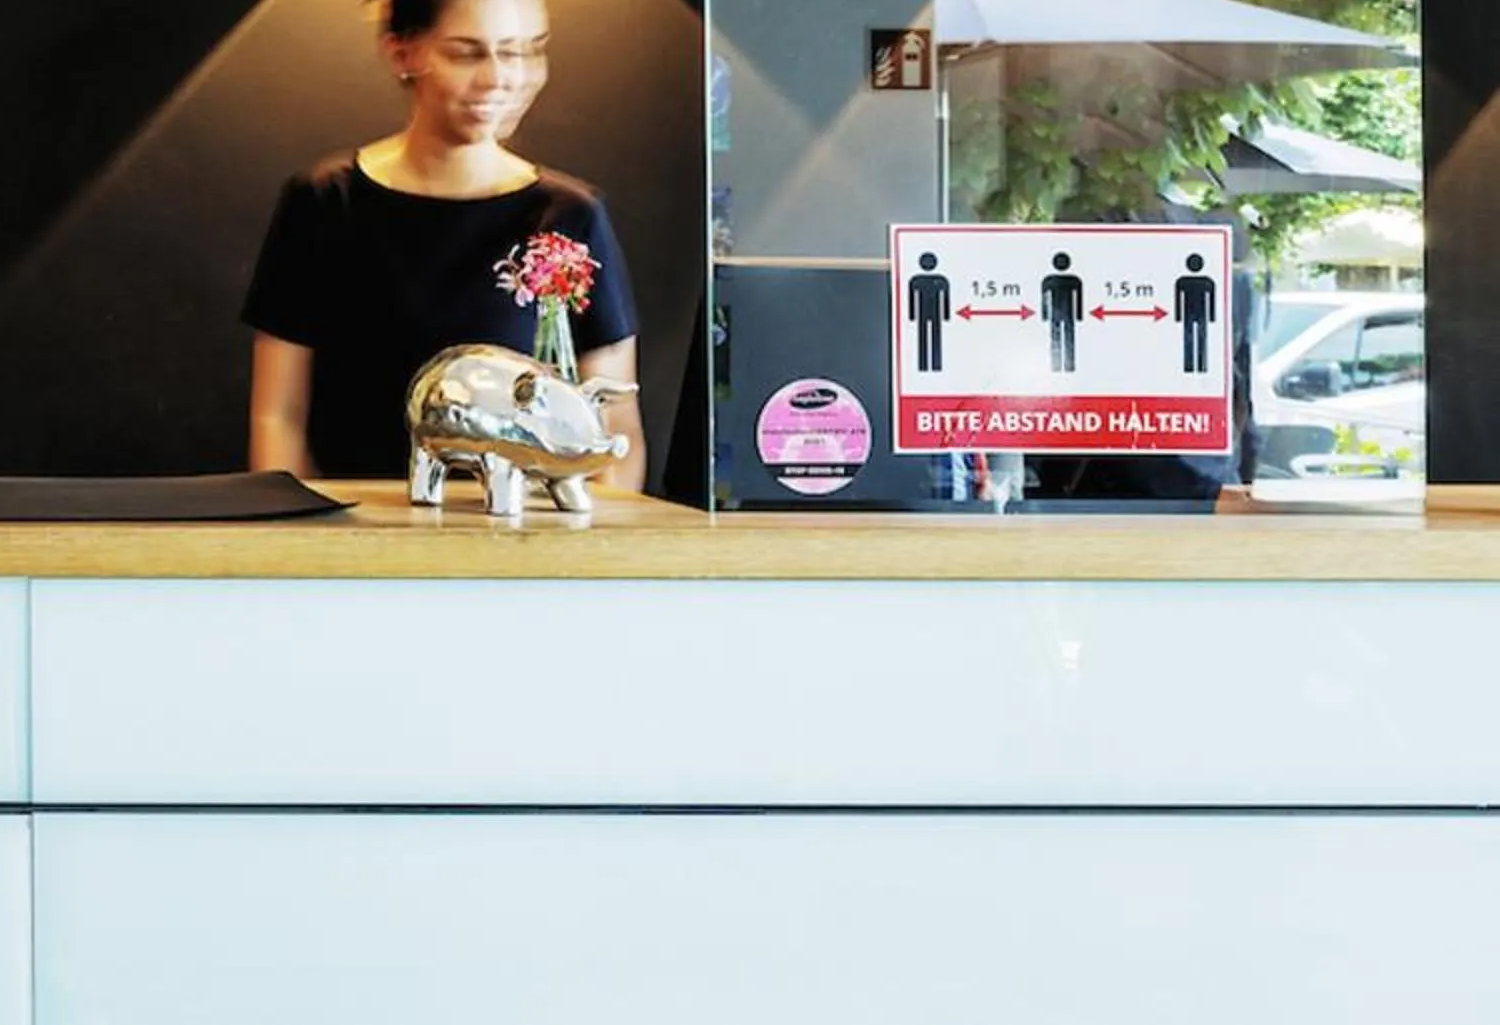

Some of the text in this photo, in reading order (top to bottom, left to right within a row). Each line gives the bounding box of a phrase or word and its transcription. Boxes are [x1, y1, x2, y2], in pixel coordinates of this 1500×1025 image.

[972, 281, 1021, 298] 1,5 m
[1105, 281, 1154, 298] 1,5 m
[916, 411, 1211, 434] BITTE ABSTAND HALTEN!
